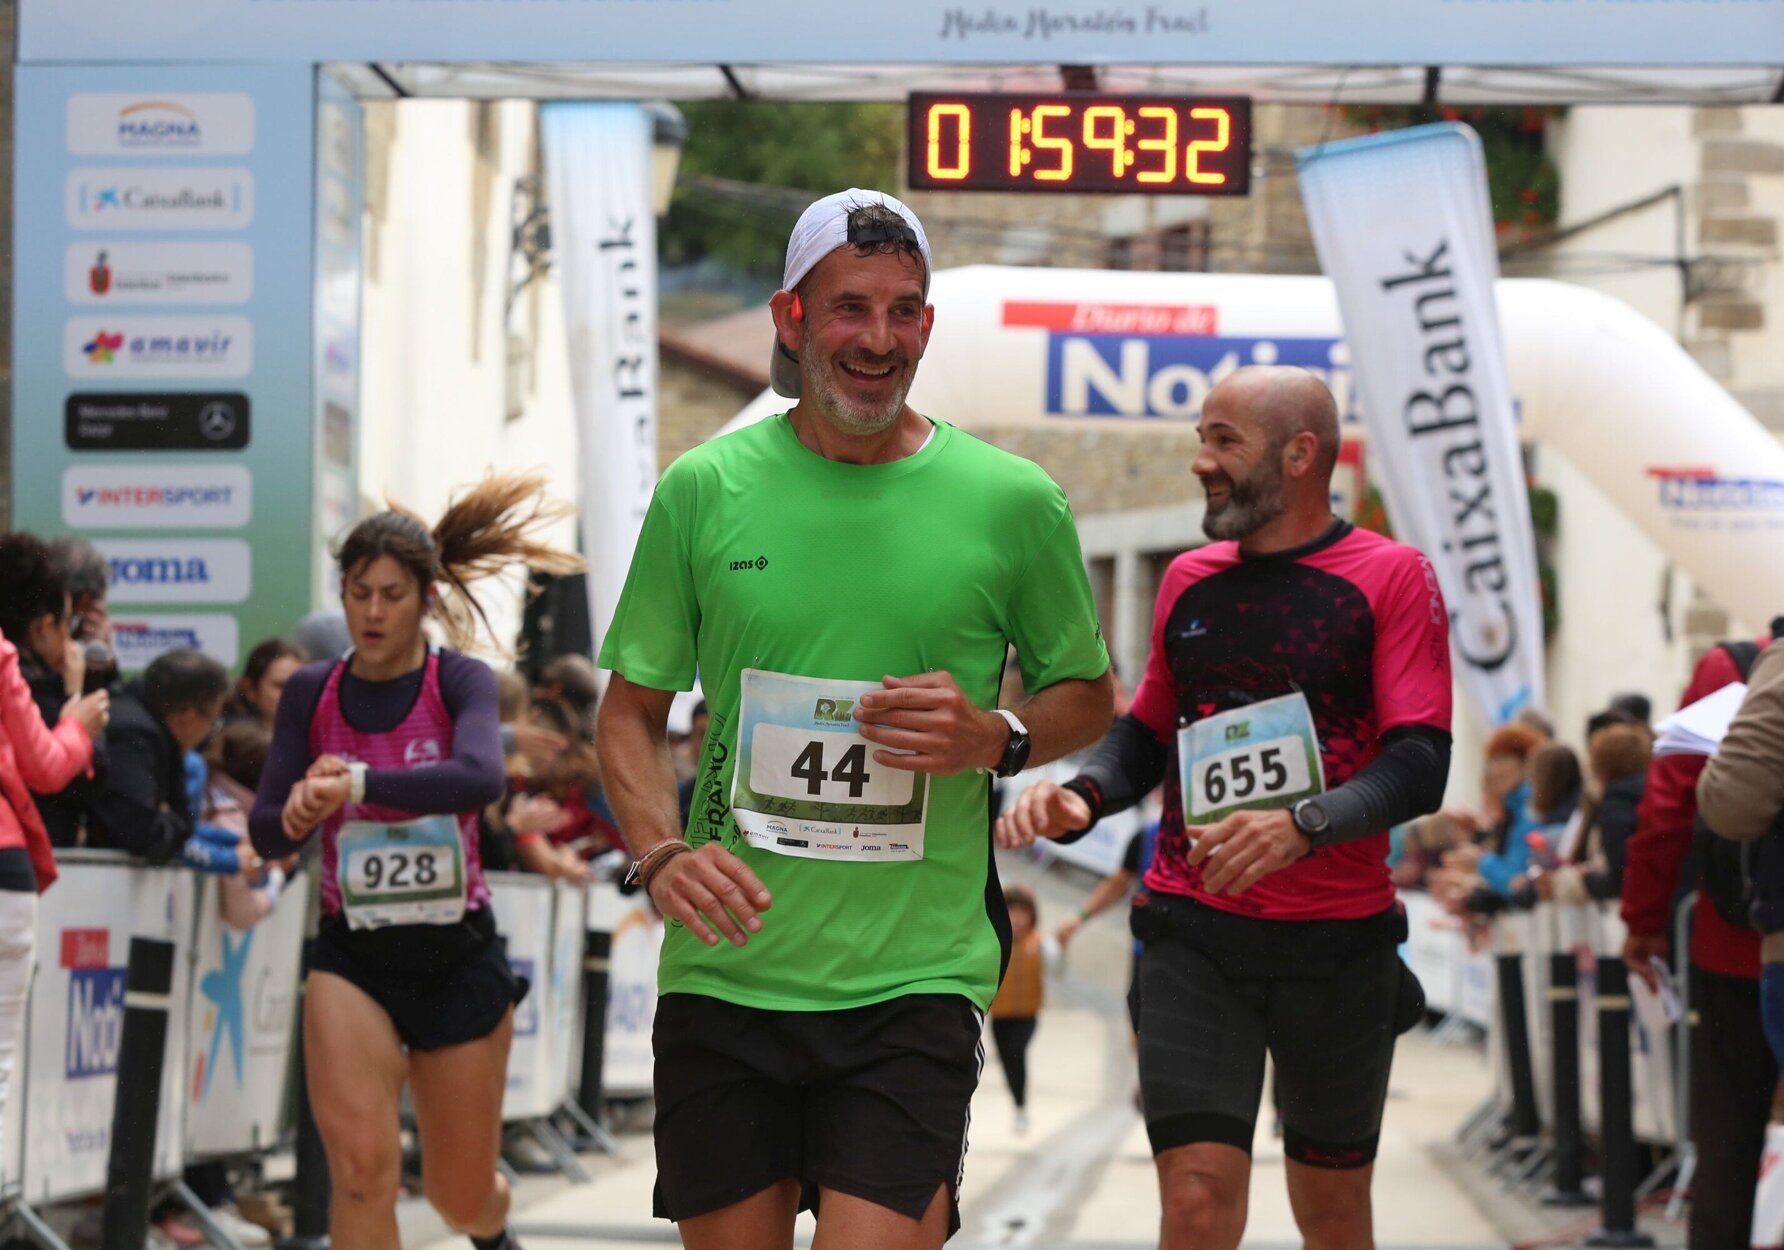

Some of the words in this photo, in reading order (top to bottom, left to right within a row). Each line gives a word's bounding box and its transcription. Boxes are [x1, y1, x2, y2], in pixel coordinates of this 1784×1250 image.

[118, 121, 199, 137] MAGNA
[123, 185, 226, 211] CaixaBank
[130, 330, 232, 353] amavir
[1381, 237, 1517, 673] CaixaBank
[98, 486, 233, 506] INTERSPORT
[791, 741, 870, 797] 44
[1204, 748, 1287, 804] 655
[363, 852, 437, 889] 928
